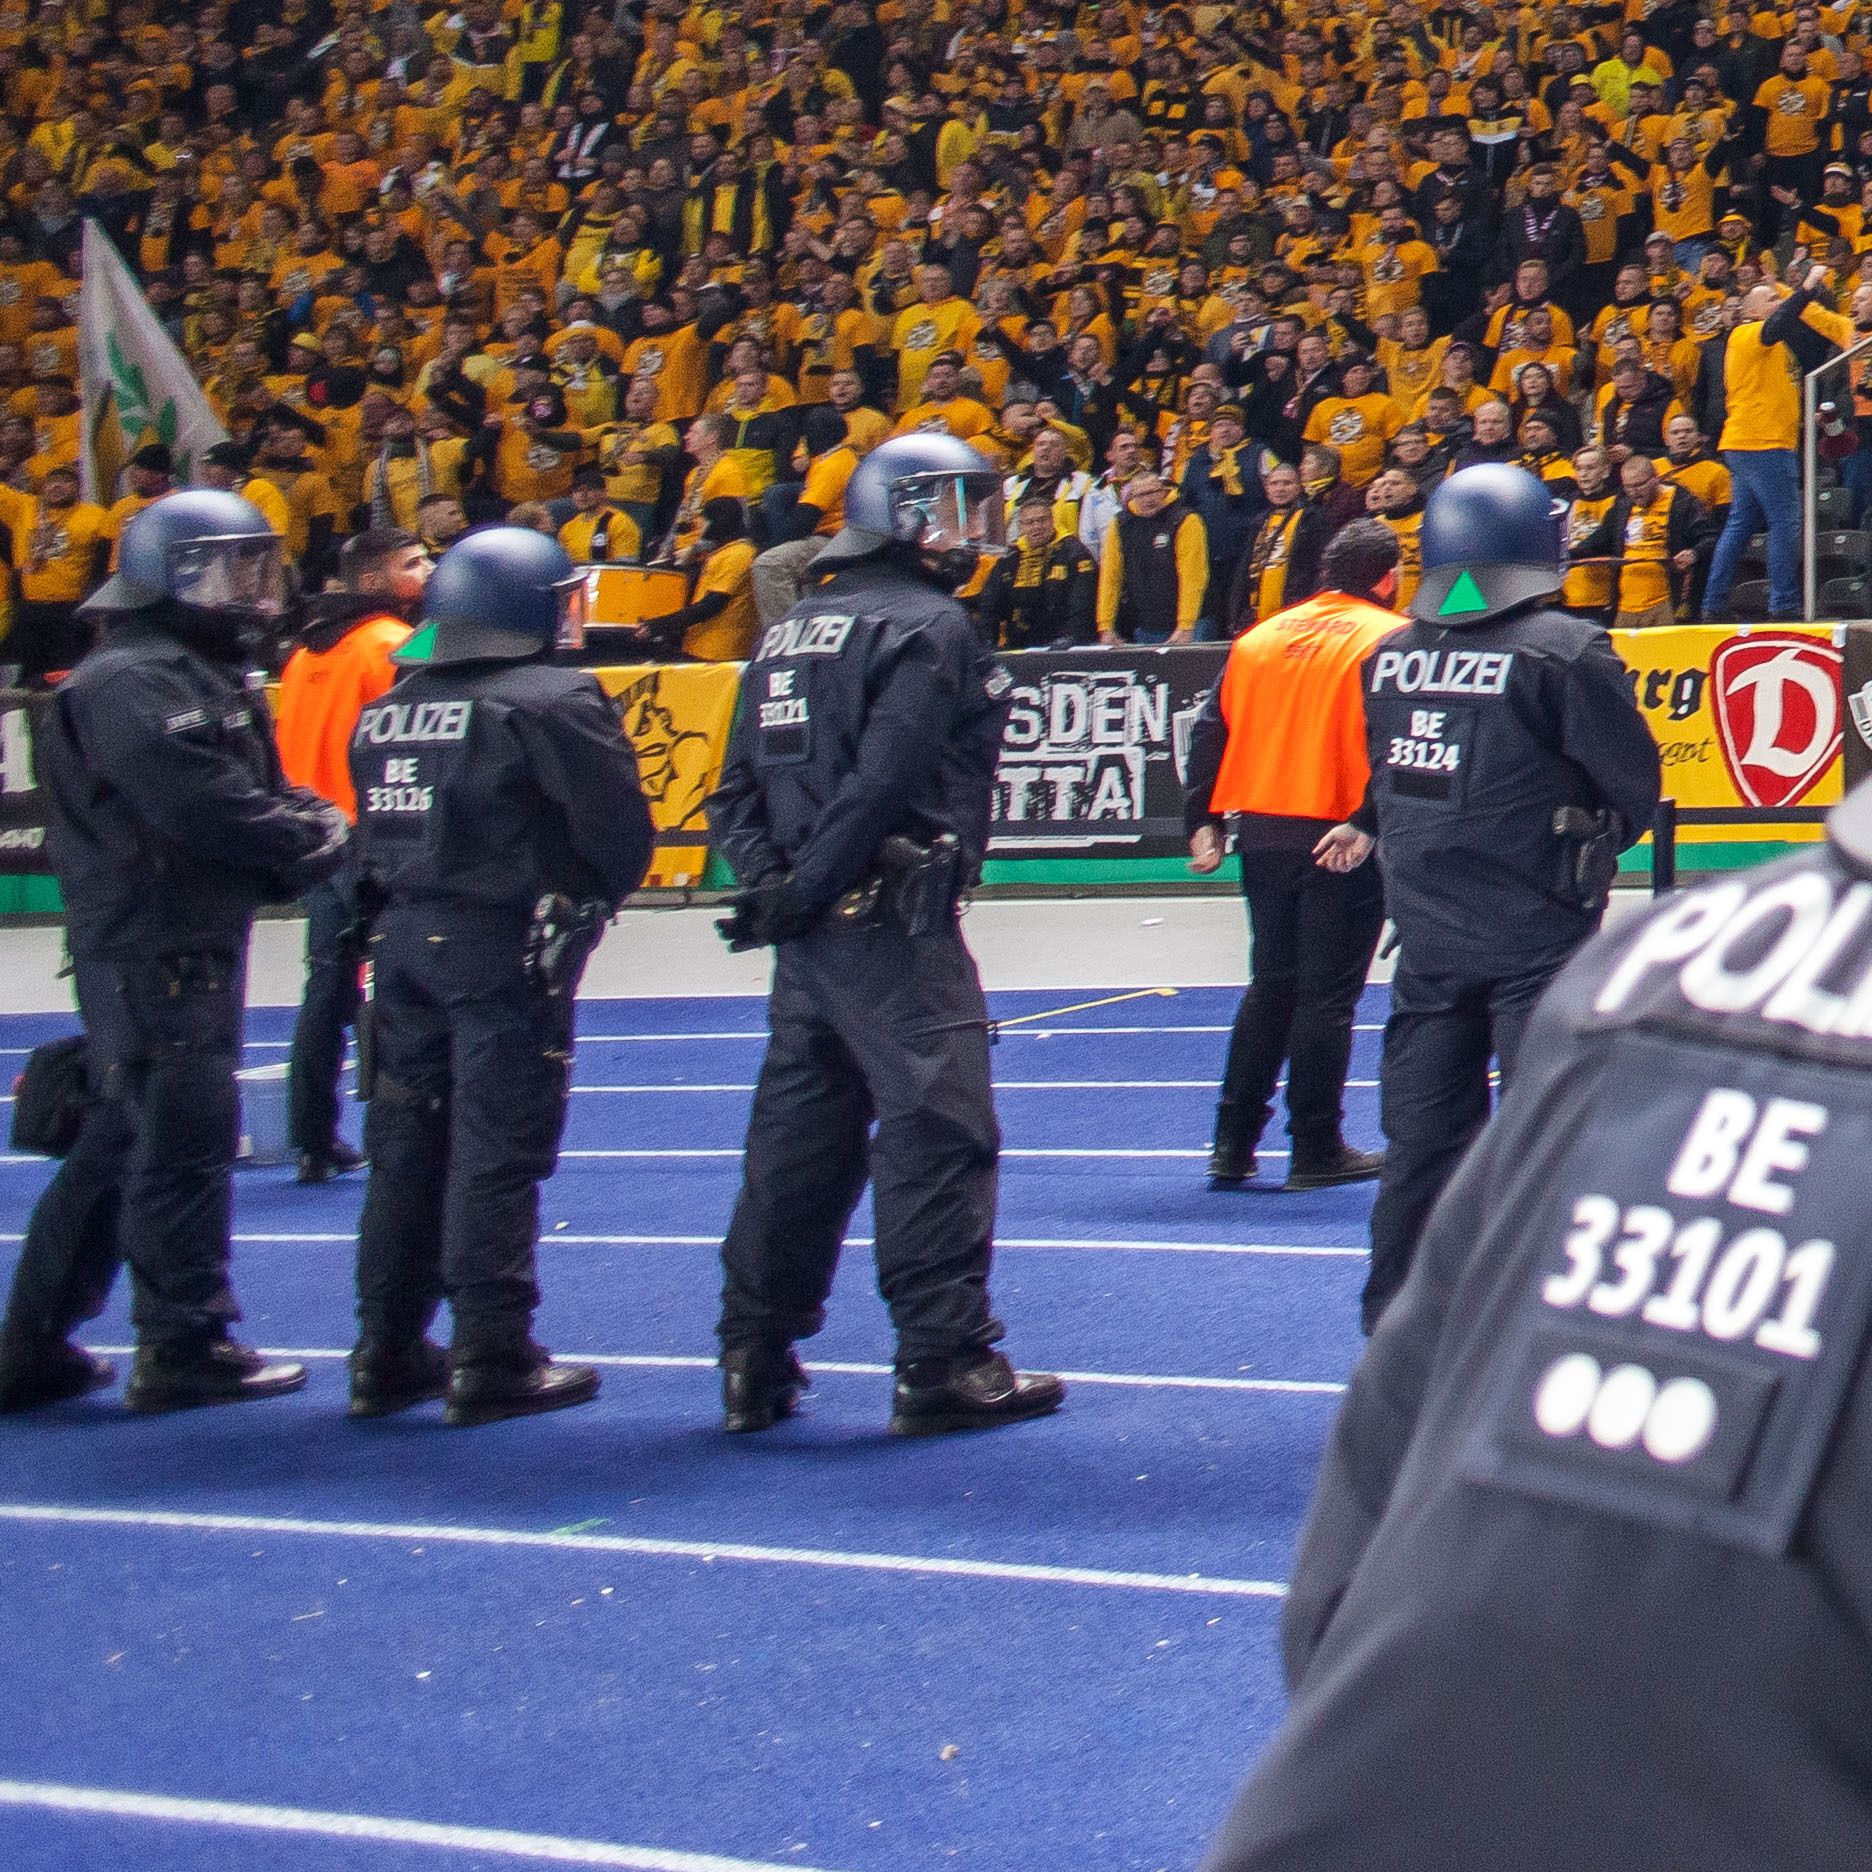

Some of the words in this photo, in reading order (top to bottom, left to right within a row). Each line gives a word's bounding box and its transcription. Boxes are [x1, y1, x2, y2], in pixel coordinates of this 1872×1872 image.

[755, 615, 856, 663] POLIZEI
[1370, 649, 1513, 694] POLIZEI
[354, 700, 474, 749] POLIZEI
[1410, 710, 1447, 739] BE
[385, 757, 419, 784] BE
[1386, 737, 1460, 772] 33124
[1666, 1087, 1828, 1215] BE
[1540, 1194, 1837, 1361] 33101
